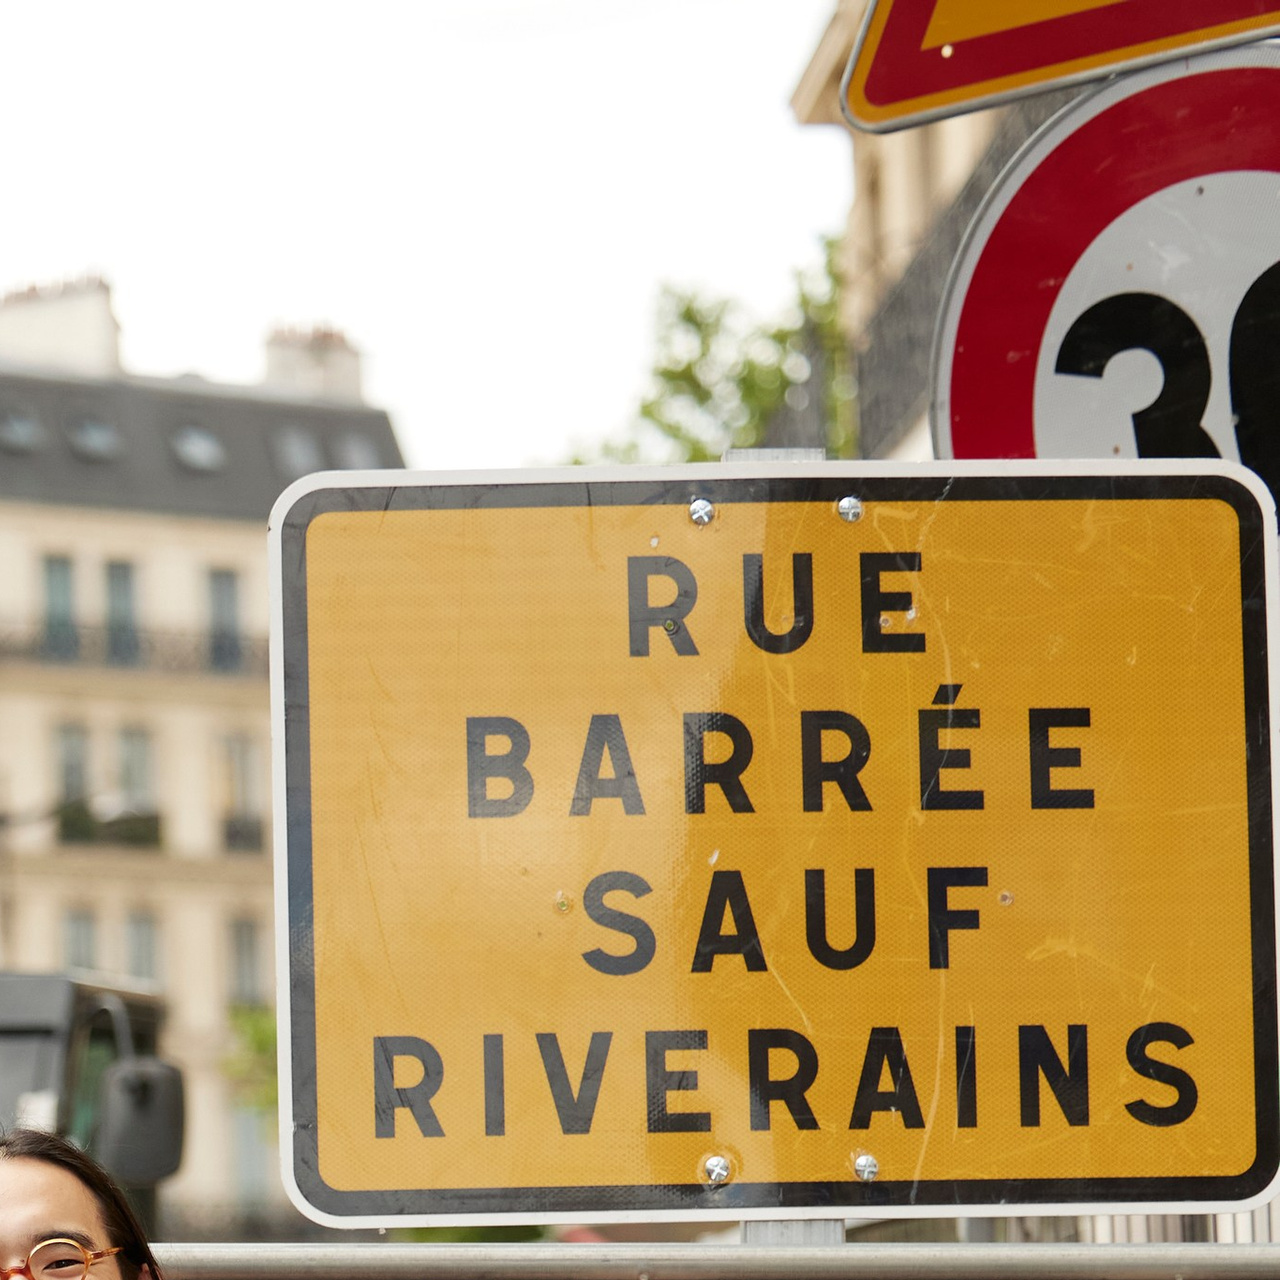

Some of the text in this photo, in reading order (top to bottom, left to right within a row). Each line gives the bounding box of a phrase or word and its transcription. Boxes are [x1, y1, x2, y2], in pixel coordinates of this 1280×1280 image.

[627, 551, 926, 657] RUE
[465, 683, 1096, 819] BARRÉE
[581, 866, 988, 976] SAUF
[373, 1021, 1199, 1139] RIVERAINS
